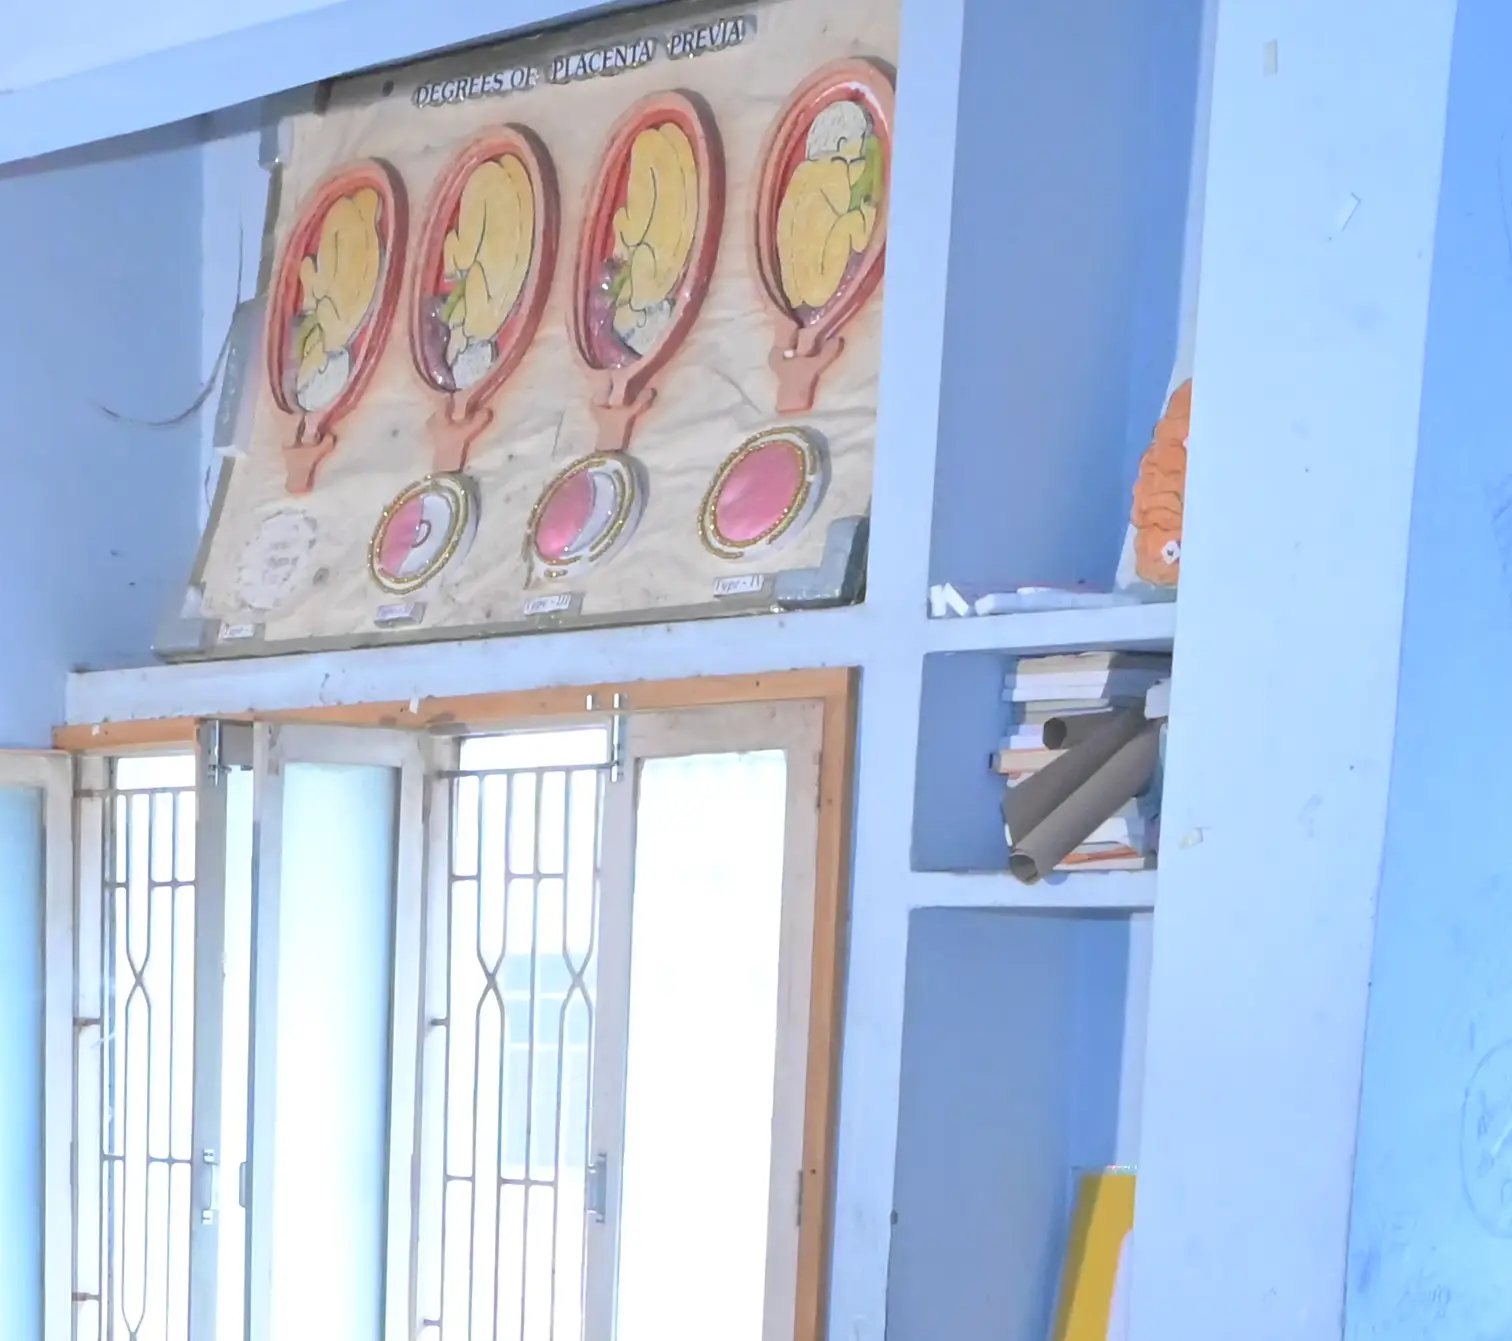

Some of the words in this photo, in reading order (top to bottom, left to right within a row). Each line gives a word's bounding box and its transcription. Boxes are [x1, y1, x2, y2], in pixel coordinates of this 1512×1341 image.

[415, 71, 504, 107] DEGREES
[550, 40, 653, 82] PLACENTA
[669, 18, 745, 56] PREVIA
